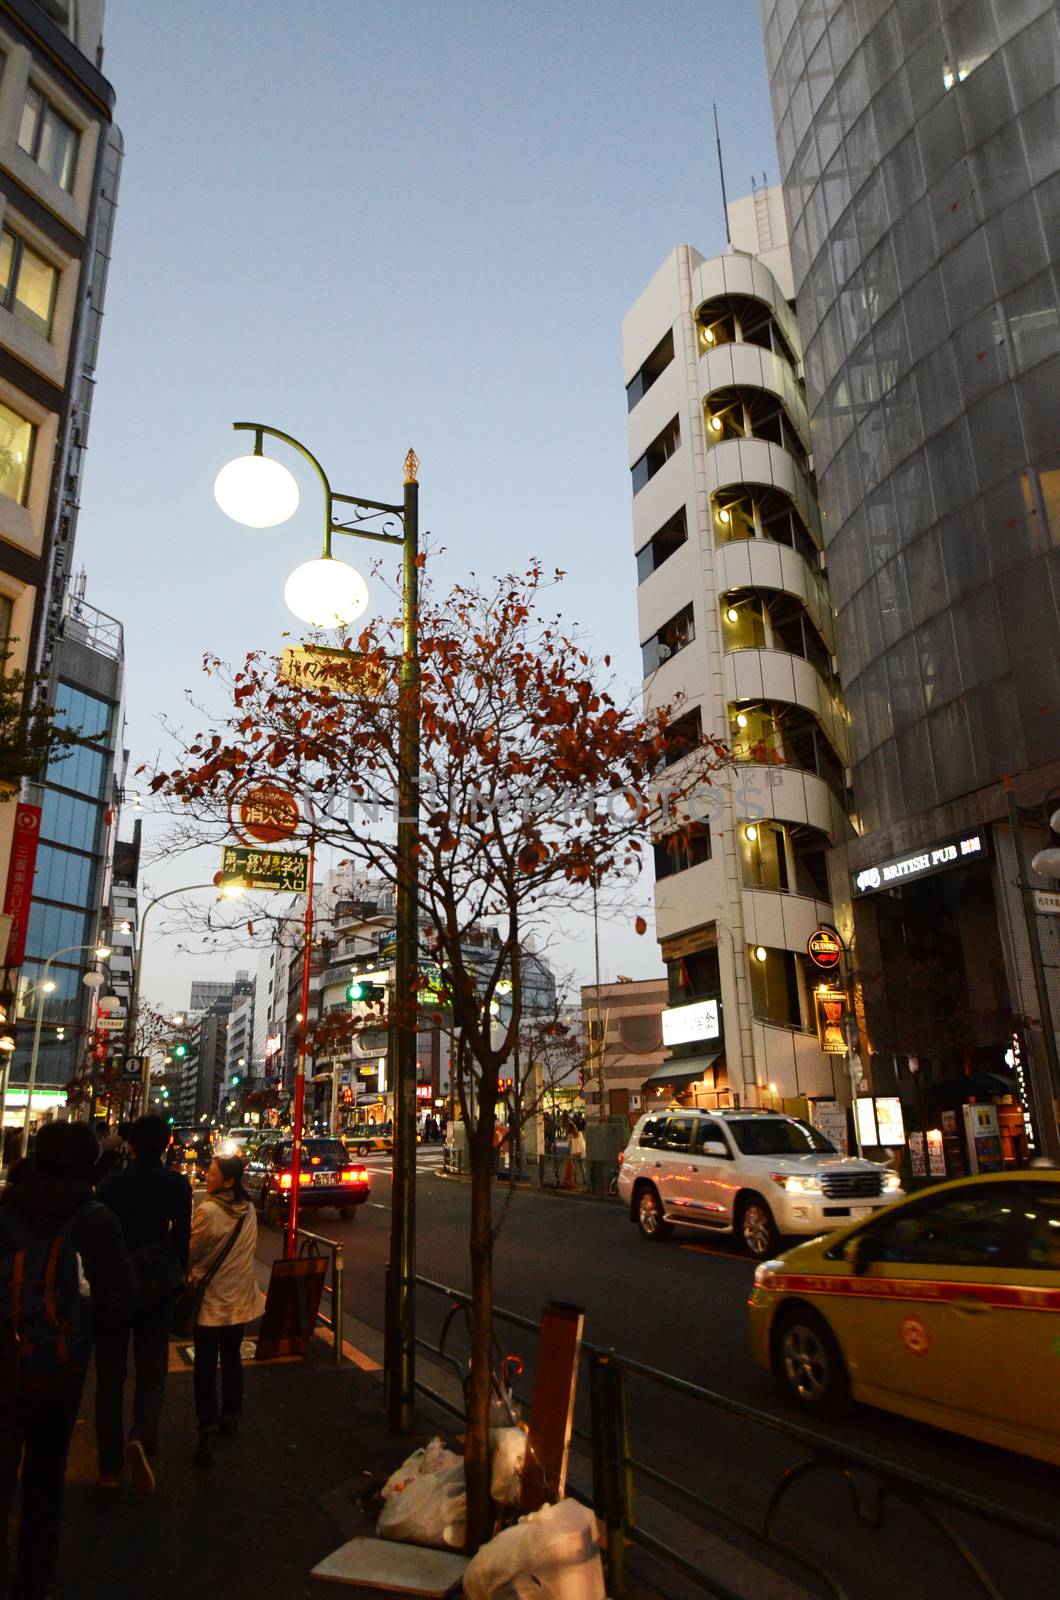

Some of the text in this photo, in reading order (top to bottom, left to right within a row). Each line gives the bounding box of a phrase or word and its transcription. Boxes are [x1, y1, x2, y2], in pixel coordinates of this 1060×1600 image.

[245, 803, 296, 827] 消火栓
[883, 854, 931, 881] BRITISH
[931, 845, 958, 865] PUB
[281, 878, 305, 891] 入口
